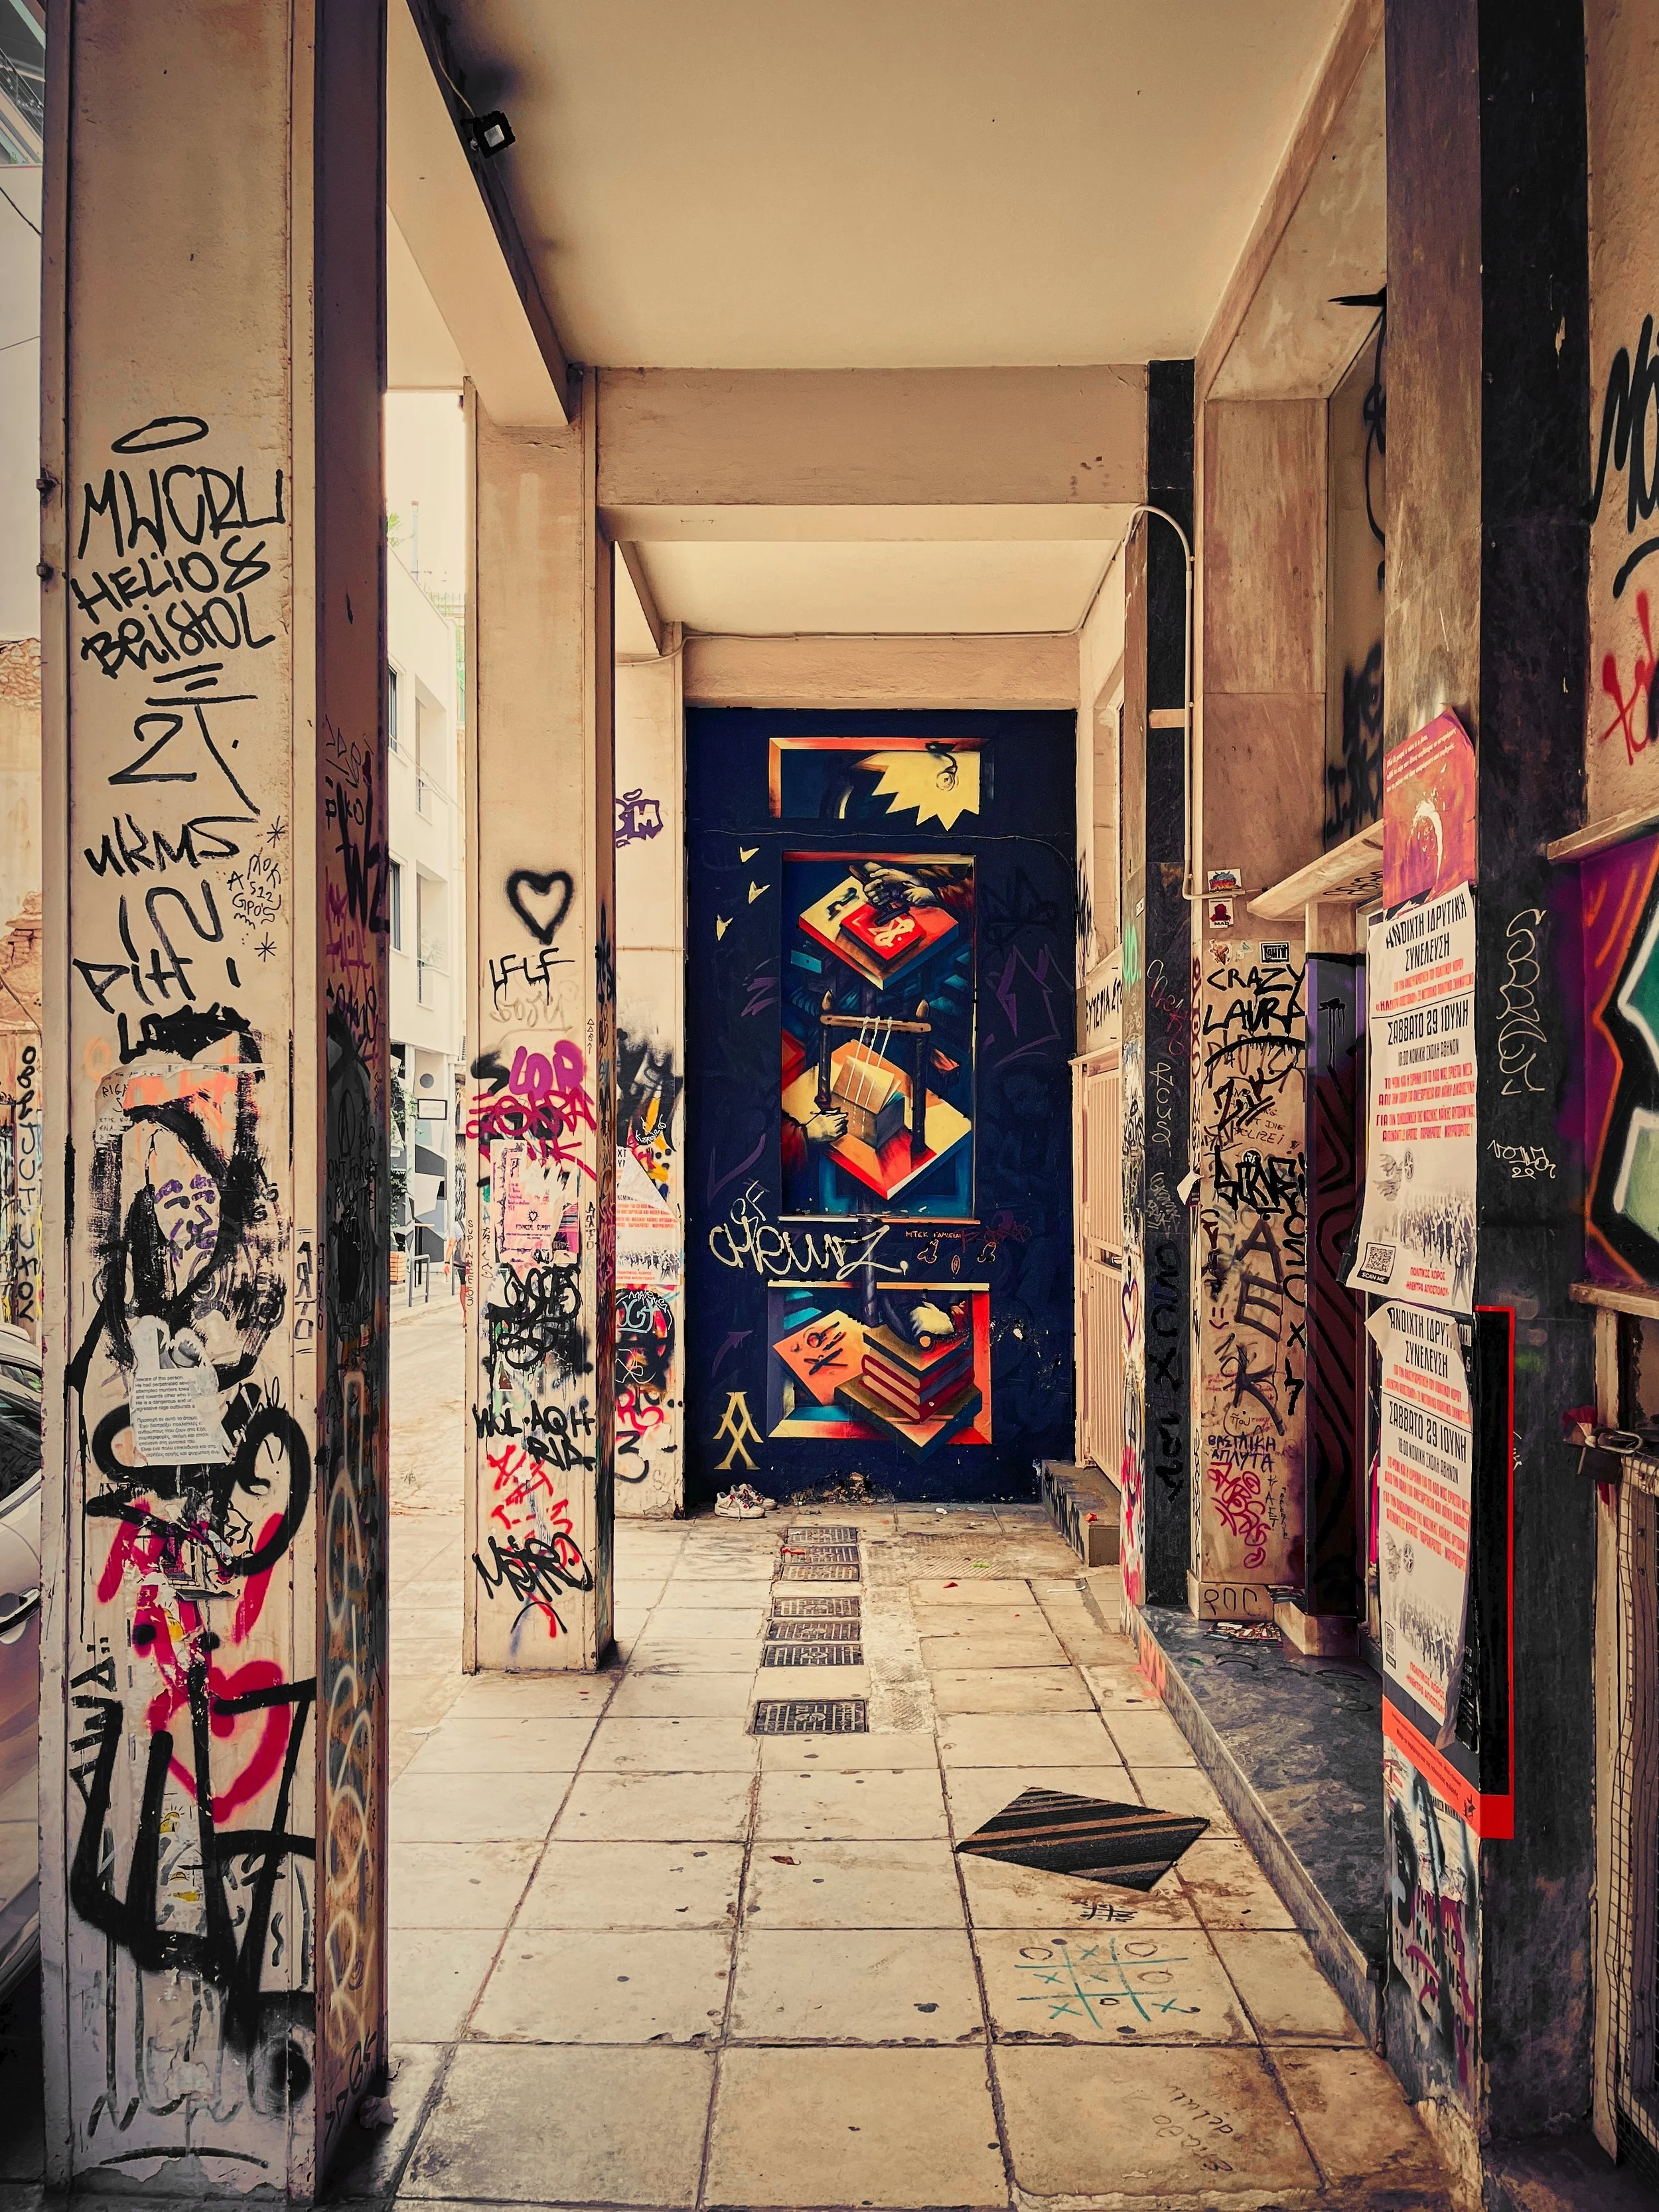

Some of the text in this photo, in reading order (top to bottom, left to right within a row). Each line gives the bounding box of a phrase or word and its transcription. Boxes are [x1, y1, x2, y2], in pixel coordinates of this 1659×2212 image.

[1386, 893, 1467, 949] ΑΝΟΙΧΤΗ ΙΔΡΥΤΙΚΗ
[1406, 932, 1449, 972] ΣΥΝΕΛΕΥΣΗ
[1207, 963, 1306, 995] CRAZY
[1388, 1000, 1469, 1045] ΣΑΒΒΑΤΟ 29 ΙΟΥΝΗ
[1265, 1119, 1285, 1130] DIE
[1376, 1114, 1388, 1126] ΓΙΑ
[1361, 1272, 1376, 1281] SCAN
[1410, 1267, 1445, 1281] ΠΟΛΙΤΙΚΟΣ ΧΩΡΟΣ
[1387, 1307, 1423, 1339] ΑΝΟΙΧΤΗ
[1406, 1340, 1448, 1378] ΣΥΝΕΛΕΥΣΗ
[1389, 1400, 1467, 1463] ΣΑΒΒΑΤΟ 29 ΙΟΥΝΗ
